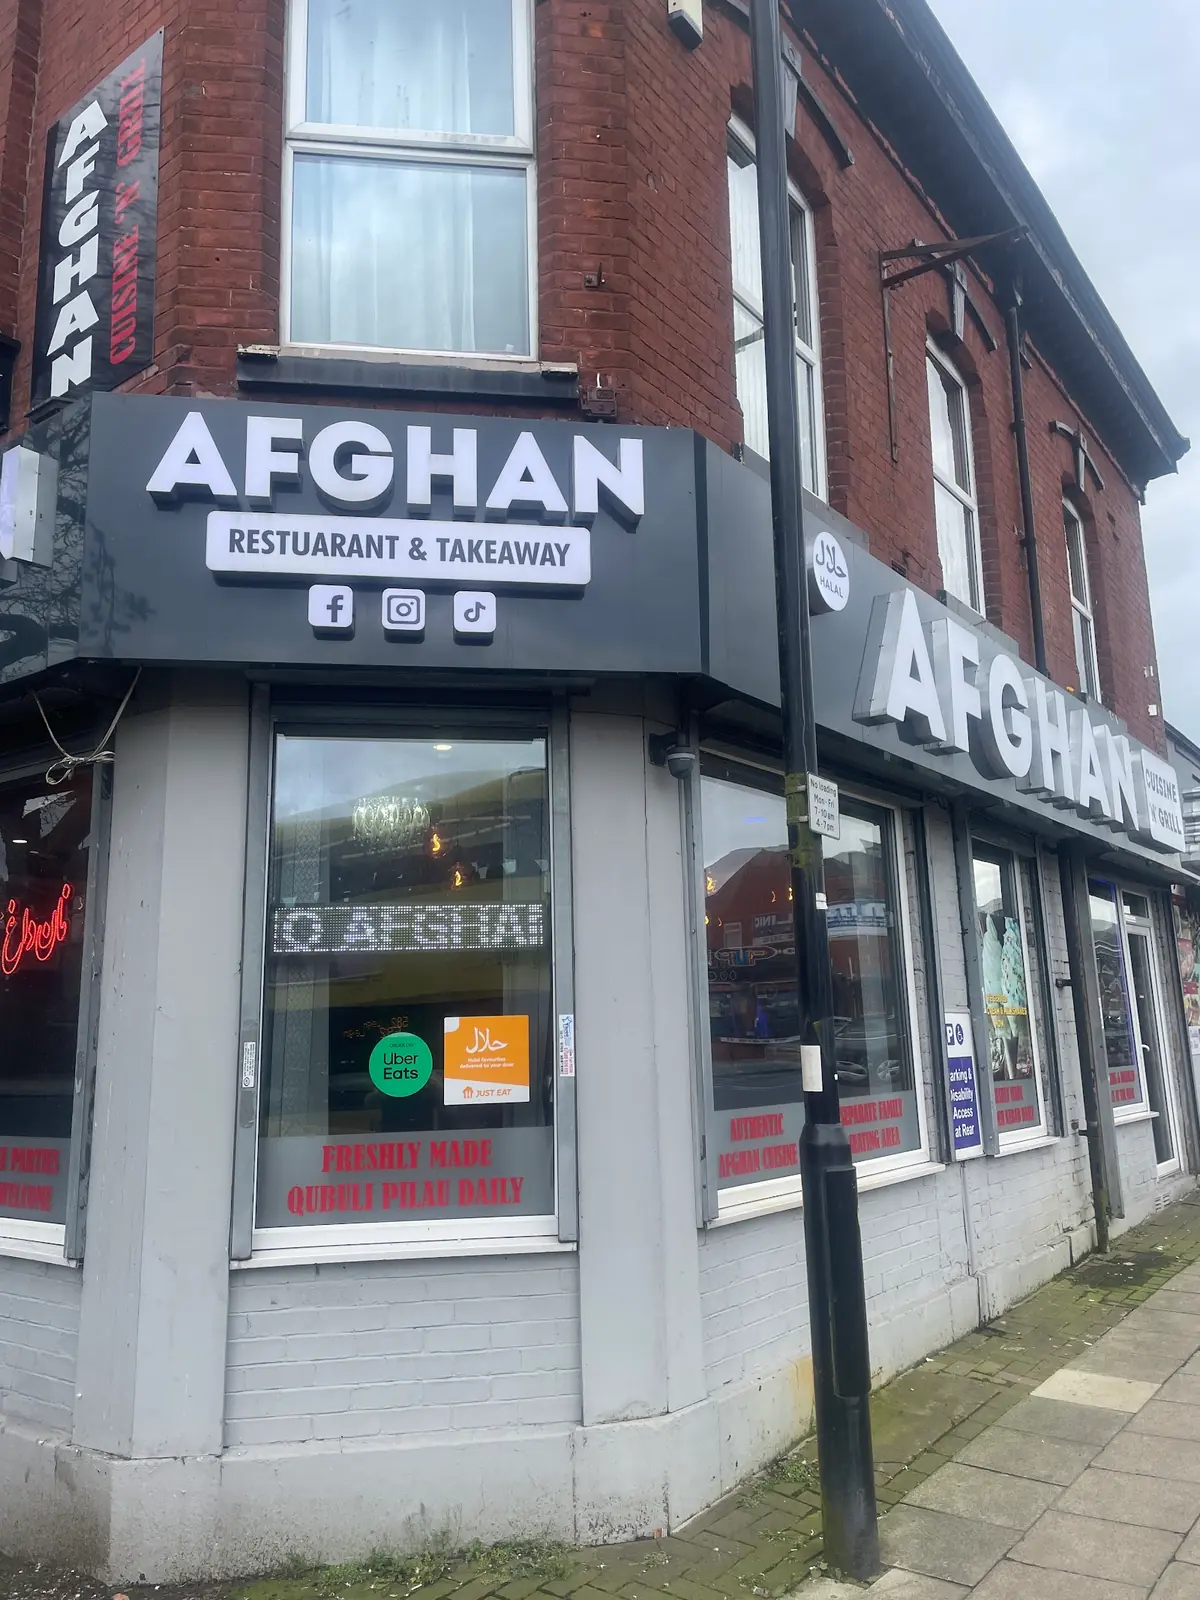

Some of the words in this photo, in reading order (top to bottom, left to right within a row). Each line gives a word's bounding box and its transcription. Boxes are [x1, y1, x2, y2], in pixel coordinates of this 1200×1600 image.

[117, 57, 146, 167] GRILL
[47, 100, 108, 397] AFGHAN
[110, 225, 139, 364] CUISINE
[146, 412, 644, 517] AFGHAN
[228, 529, 399, 560] RESTUARANT
[408, 540, 427, 561] &
[436, 538, 570, 567] TAKEAWAY
[816, 540, 846, 577] حلال
[820, 576, 844, 598] HALAL
[886, 588, 1139, 831] AFGHAN
[810, 778, 818, 789] No
[819, 782, 837, 797] loading
[1145, 768, 1178, 803] CUISINE
[1158, 807, 1182, 835] GRILL
[466, 1027, 508, 1054] حلال
[383, 1052, 419, 1065] Uber
[383, 1067, 419, 1080] Eats
[949, 1068, 968, 1083] arking
[968, 1068, 972, 1079] &
[475, 1089, 494, 1098] JUST
[496, 1088, 512, 1097] EAT
[953, 1106, 974, 1119] Access
[730, 1113, 785, 1142] AUTHENTIC
[849, 1130, 880, 1154] EATING
[882, 1127, 901, 1148] AREA
[955, 1127, 961, 1137] at
[962, 1124, 975, 1136] Rear
[321, 1141, 421, 1172] FRESHLY
[429, 1139, 493, 1169] MADE
[719, 1148, 760, 1178] AFGHAN
[763, 1143, 798, 1169] CUISINE
[287, 1182, 373, 1216] QUBULI
[381, 1179, 449, 1210] PILAU
[457, 1176, 524, 1206] DAILY
